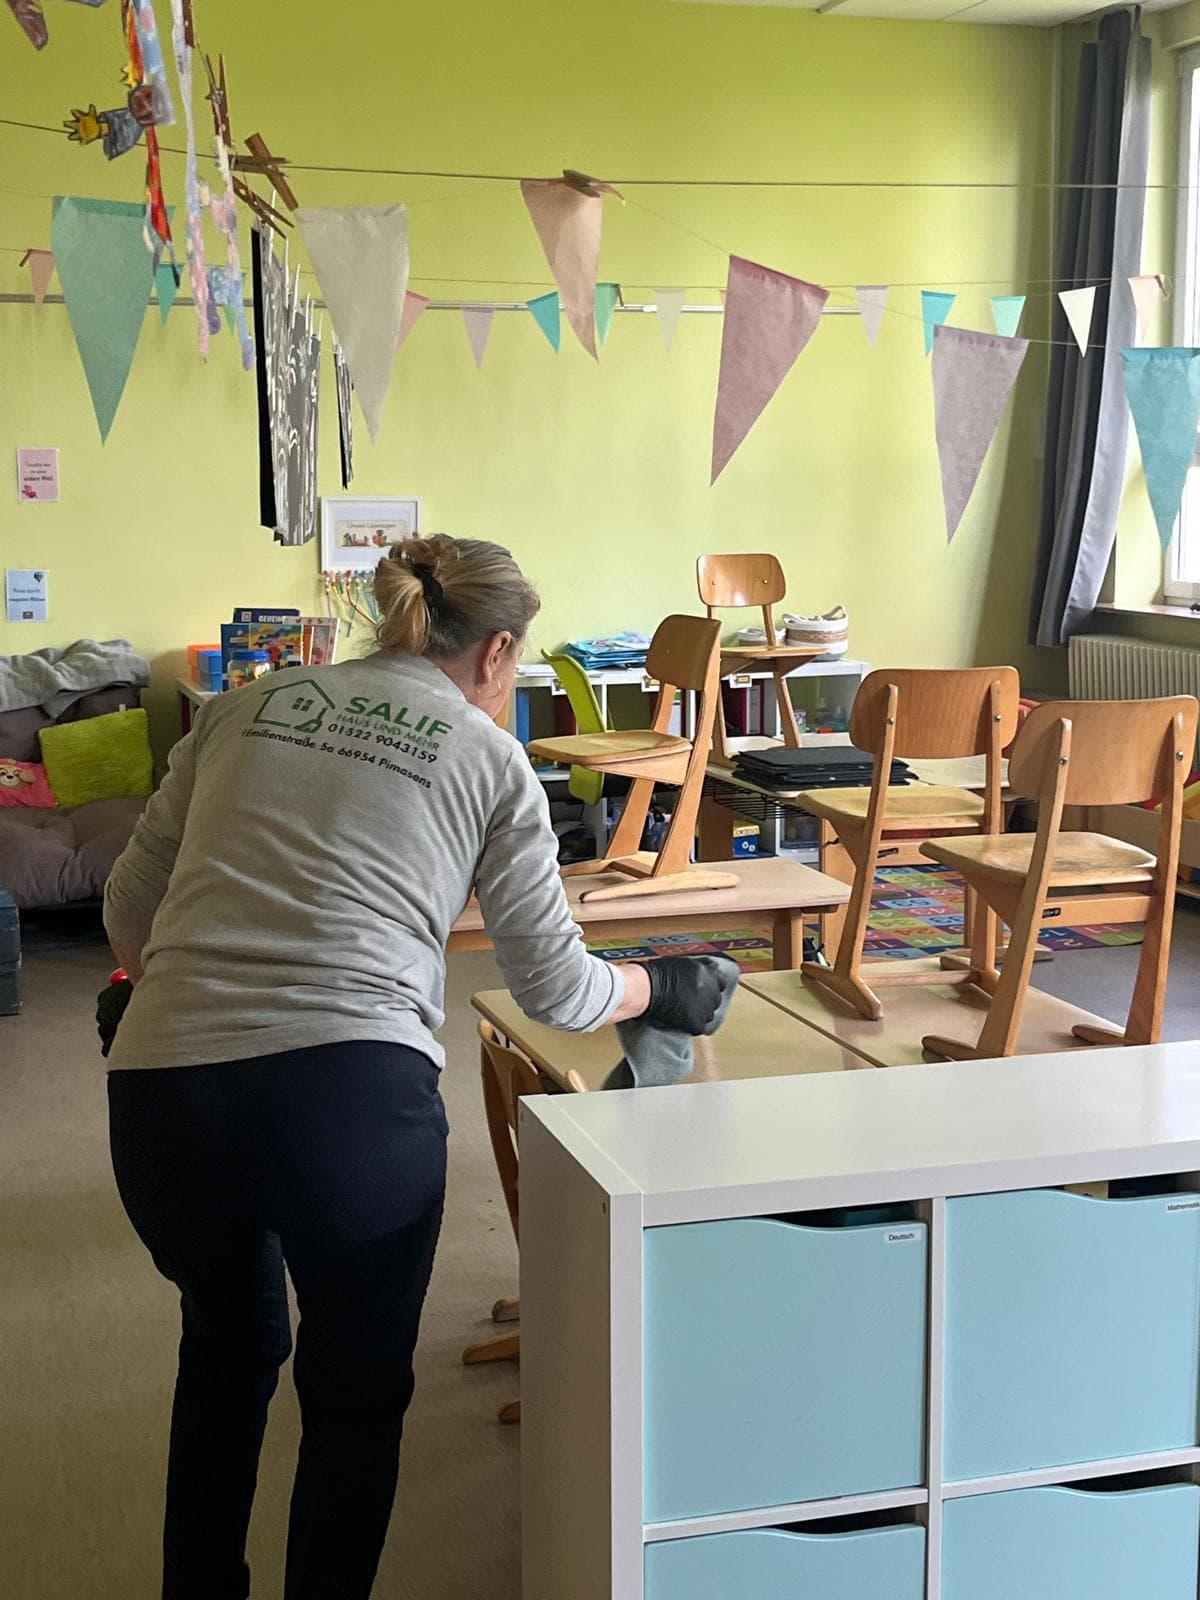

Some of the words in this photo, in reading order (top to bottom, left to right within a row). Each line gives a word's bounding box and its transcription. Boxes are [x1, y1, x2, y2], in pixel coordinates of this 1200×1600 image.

[336, 714, 371, 728] HAUS
[373, 722, 402, 736] UND
[344, 696, 453, 737] SALIF
[328, 723, 372, 741] 01522
[375, 734, 438, 763] 9043159
[603, 948, 646, 959] 29
[888, 1233, 914, 1241] Deutsch
